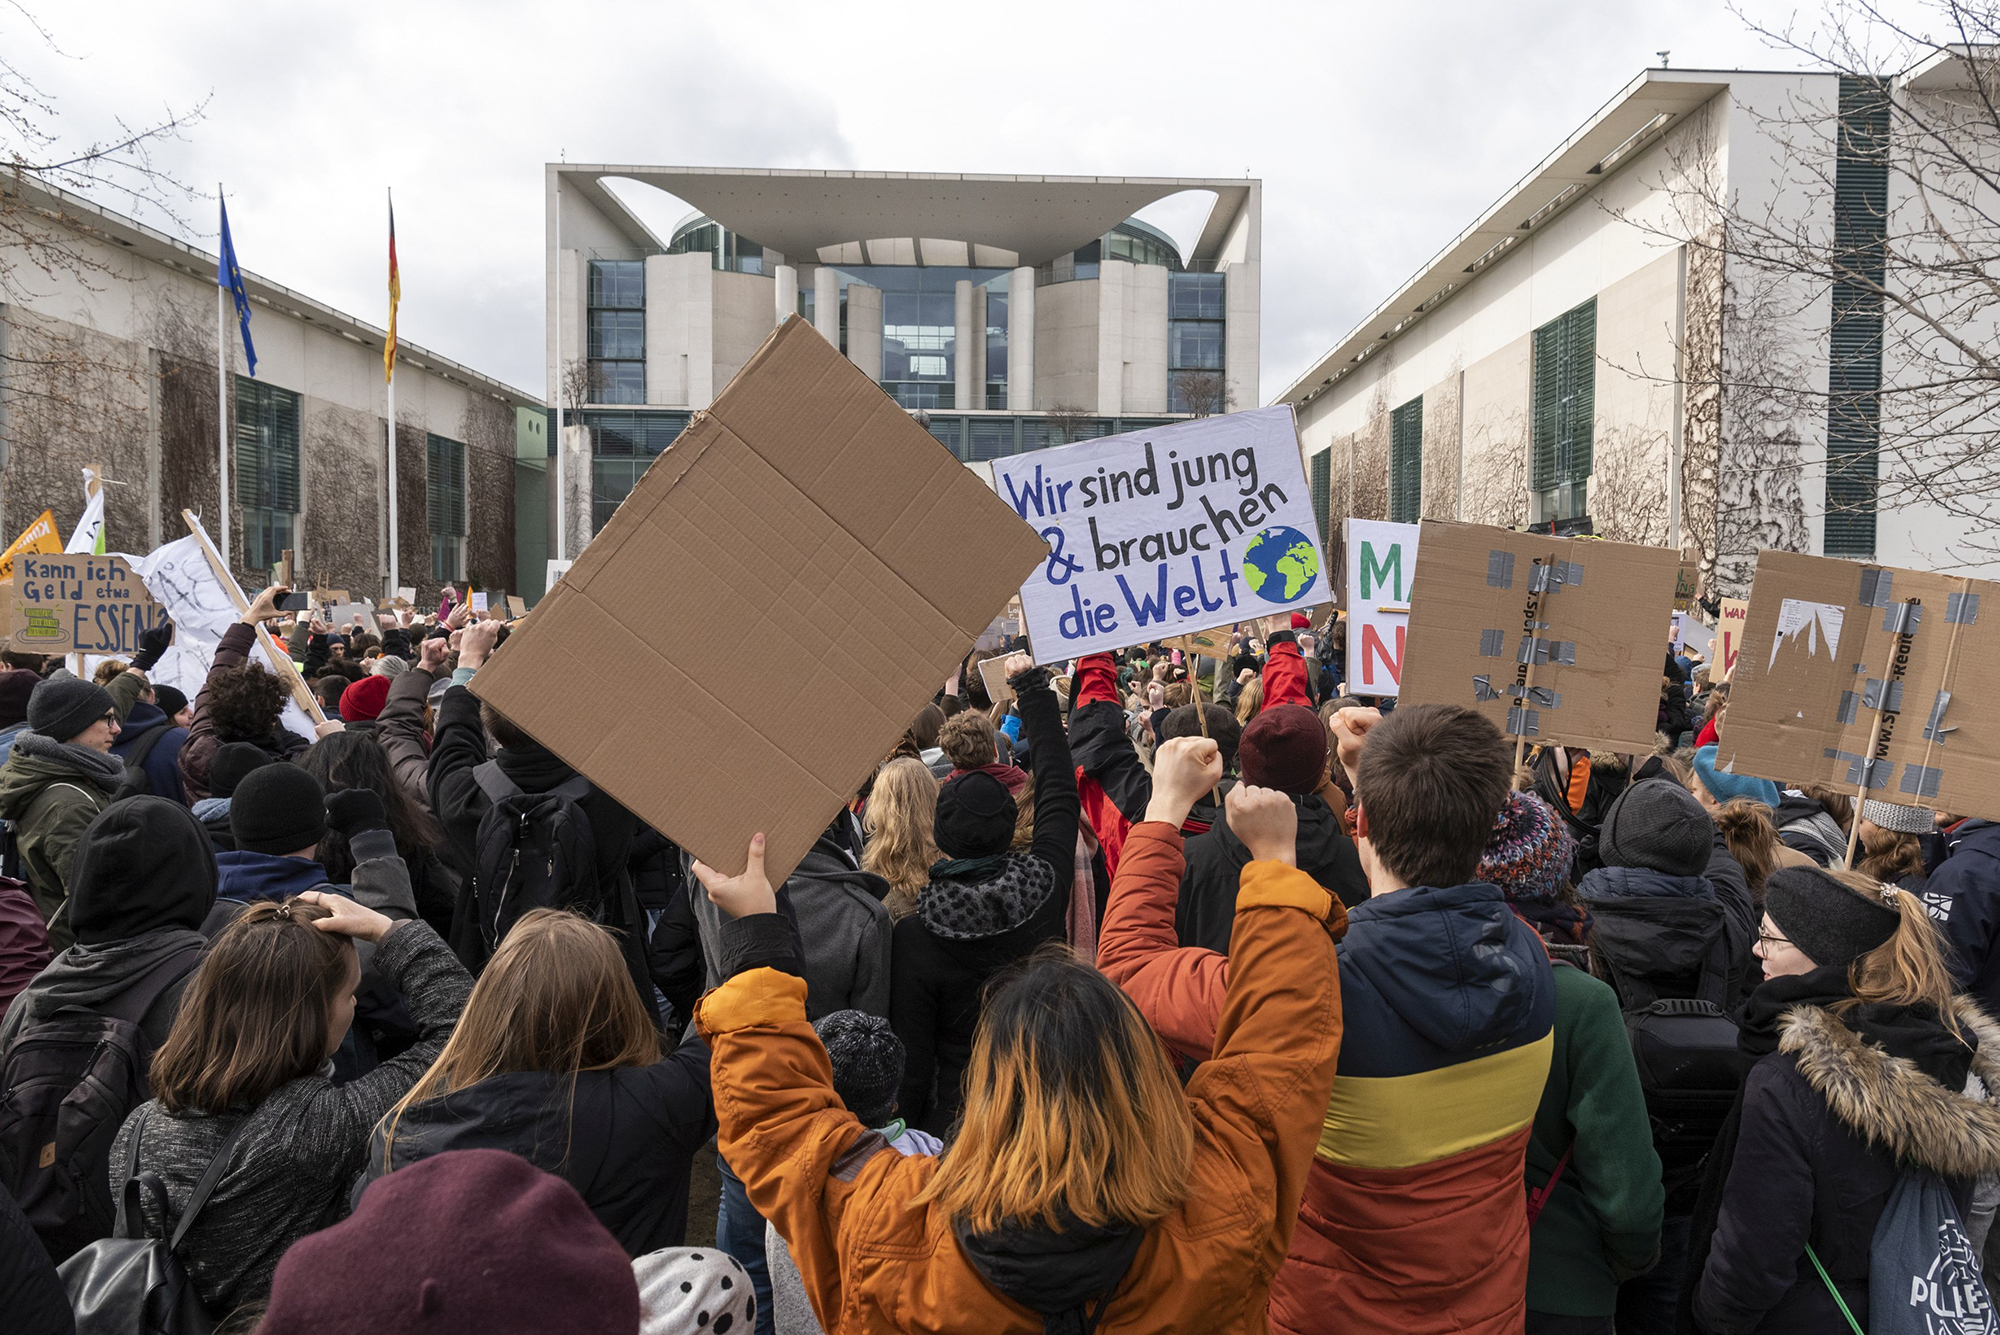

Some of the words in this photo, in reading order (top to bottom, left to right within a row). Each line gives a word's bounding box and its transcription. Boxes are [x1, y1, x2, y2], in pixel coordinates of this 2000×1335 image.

[1003, 463, 1073, 520] Wir
[1079, 442, 1160, 508] sind
[1167, 446, 1258, 510] jung
[1040, 526, 1084, 586] &
[1088, 482, 1289, 571] brauchen
[24, 560, 75, 579] Kann
[87, 560, 126, 581] ich
[24, 580, 82, 601] Geld
[96, 581, 129, 599] etwa
[1059, 583, 1119, 640] die
[1115, 549, 1239, 627] Welt
[1360, 540, 1414, 603] M
